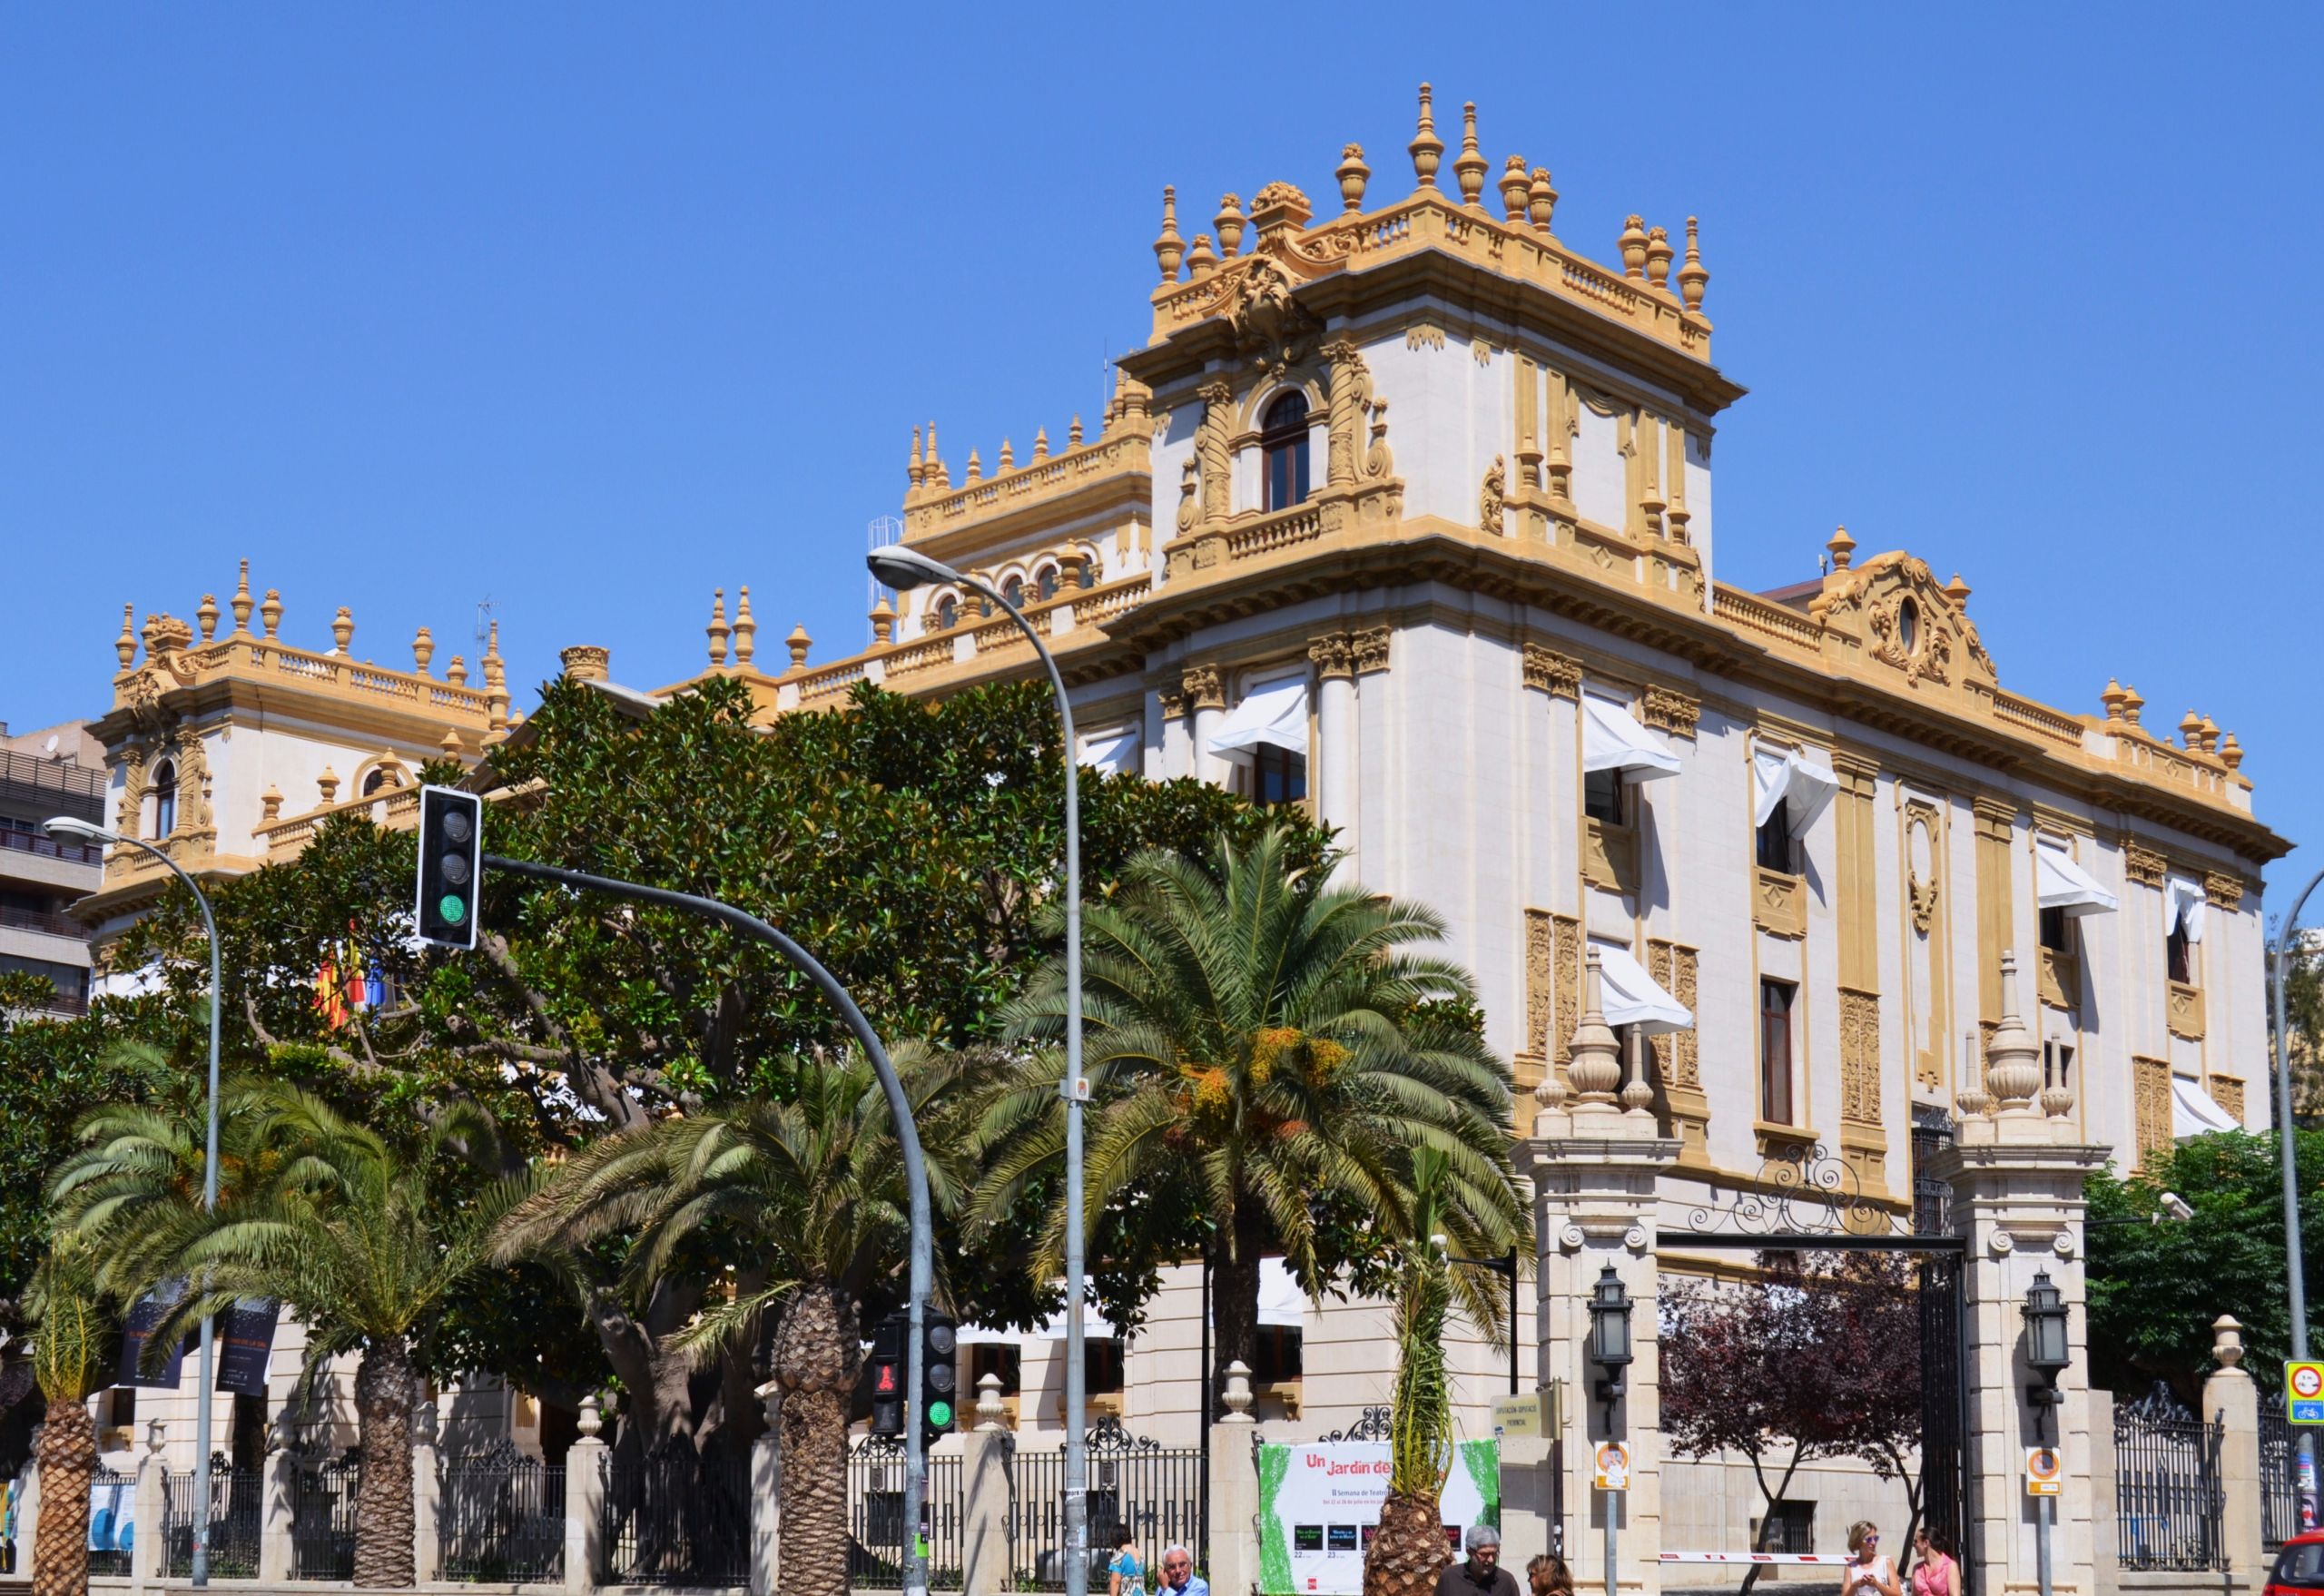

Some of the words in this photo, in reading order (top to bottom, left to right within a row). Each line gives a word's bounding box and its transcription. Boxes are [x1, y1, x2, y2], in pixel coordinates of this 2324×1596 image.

[1306, 1453, 1325, 1468] Un
[1373, 1460, 1391, 1474] de
[1337, 1489, 1361, 1497] Semana
